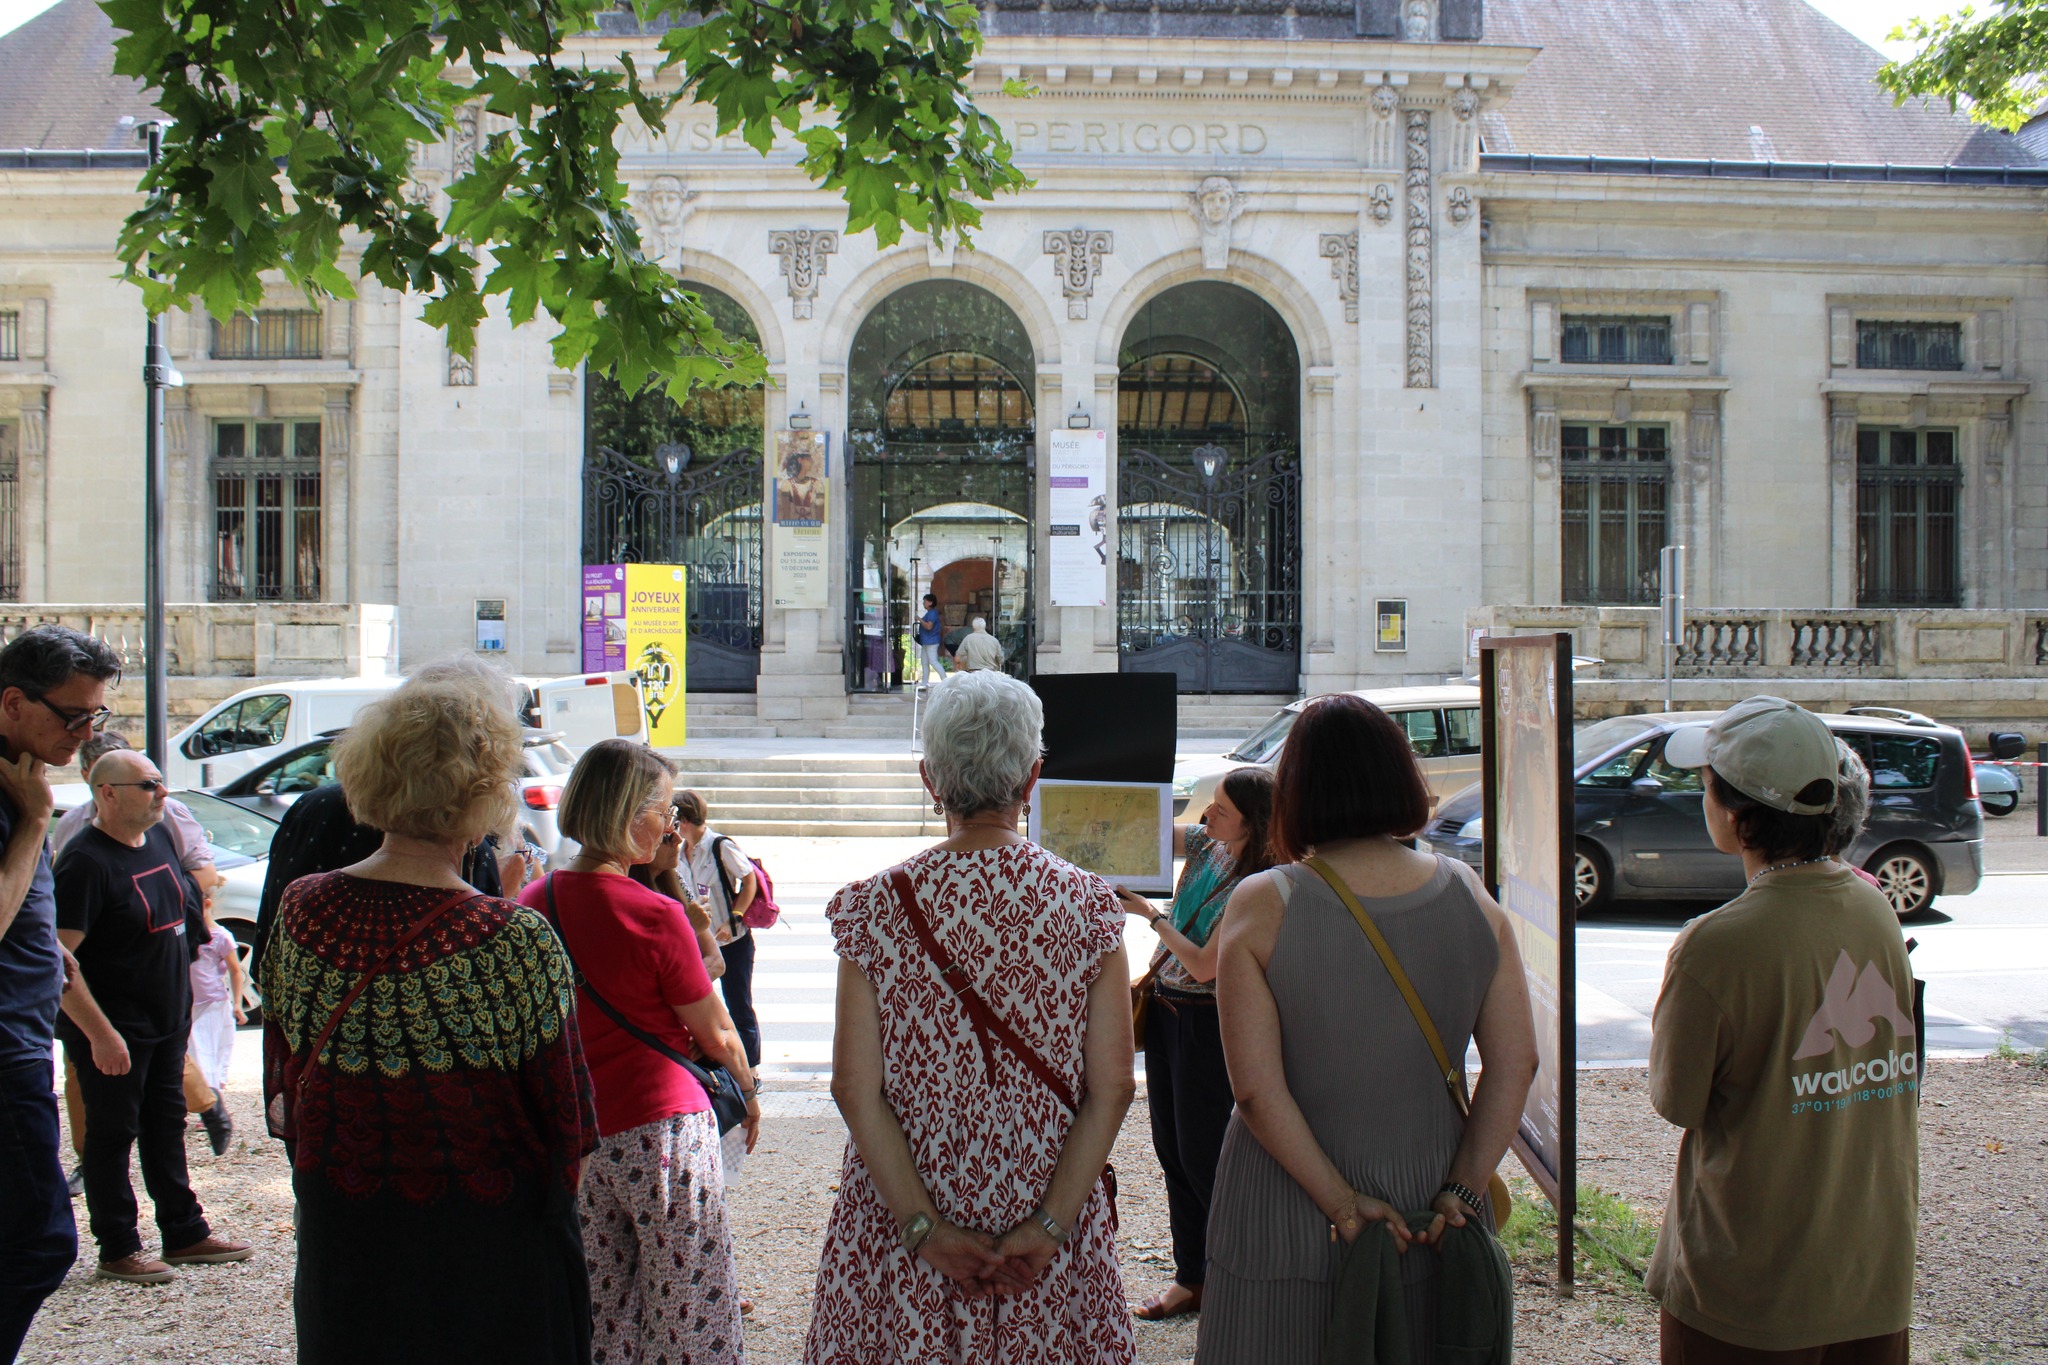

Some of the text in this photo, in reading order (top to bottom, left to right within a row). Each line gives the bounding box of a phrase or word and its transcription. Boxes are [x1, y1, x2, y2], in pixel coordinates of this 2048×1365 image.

[620, 121, 1268, 155] MVSE PERIGORD
[1052, 440, 1080, 449] MUSÉE
[631, 591, 680, 603] JOYEUX
[647, 680, 665, 691] 120
[1792, 1049, 1917, 1096] waucoba
